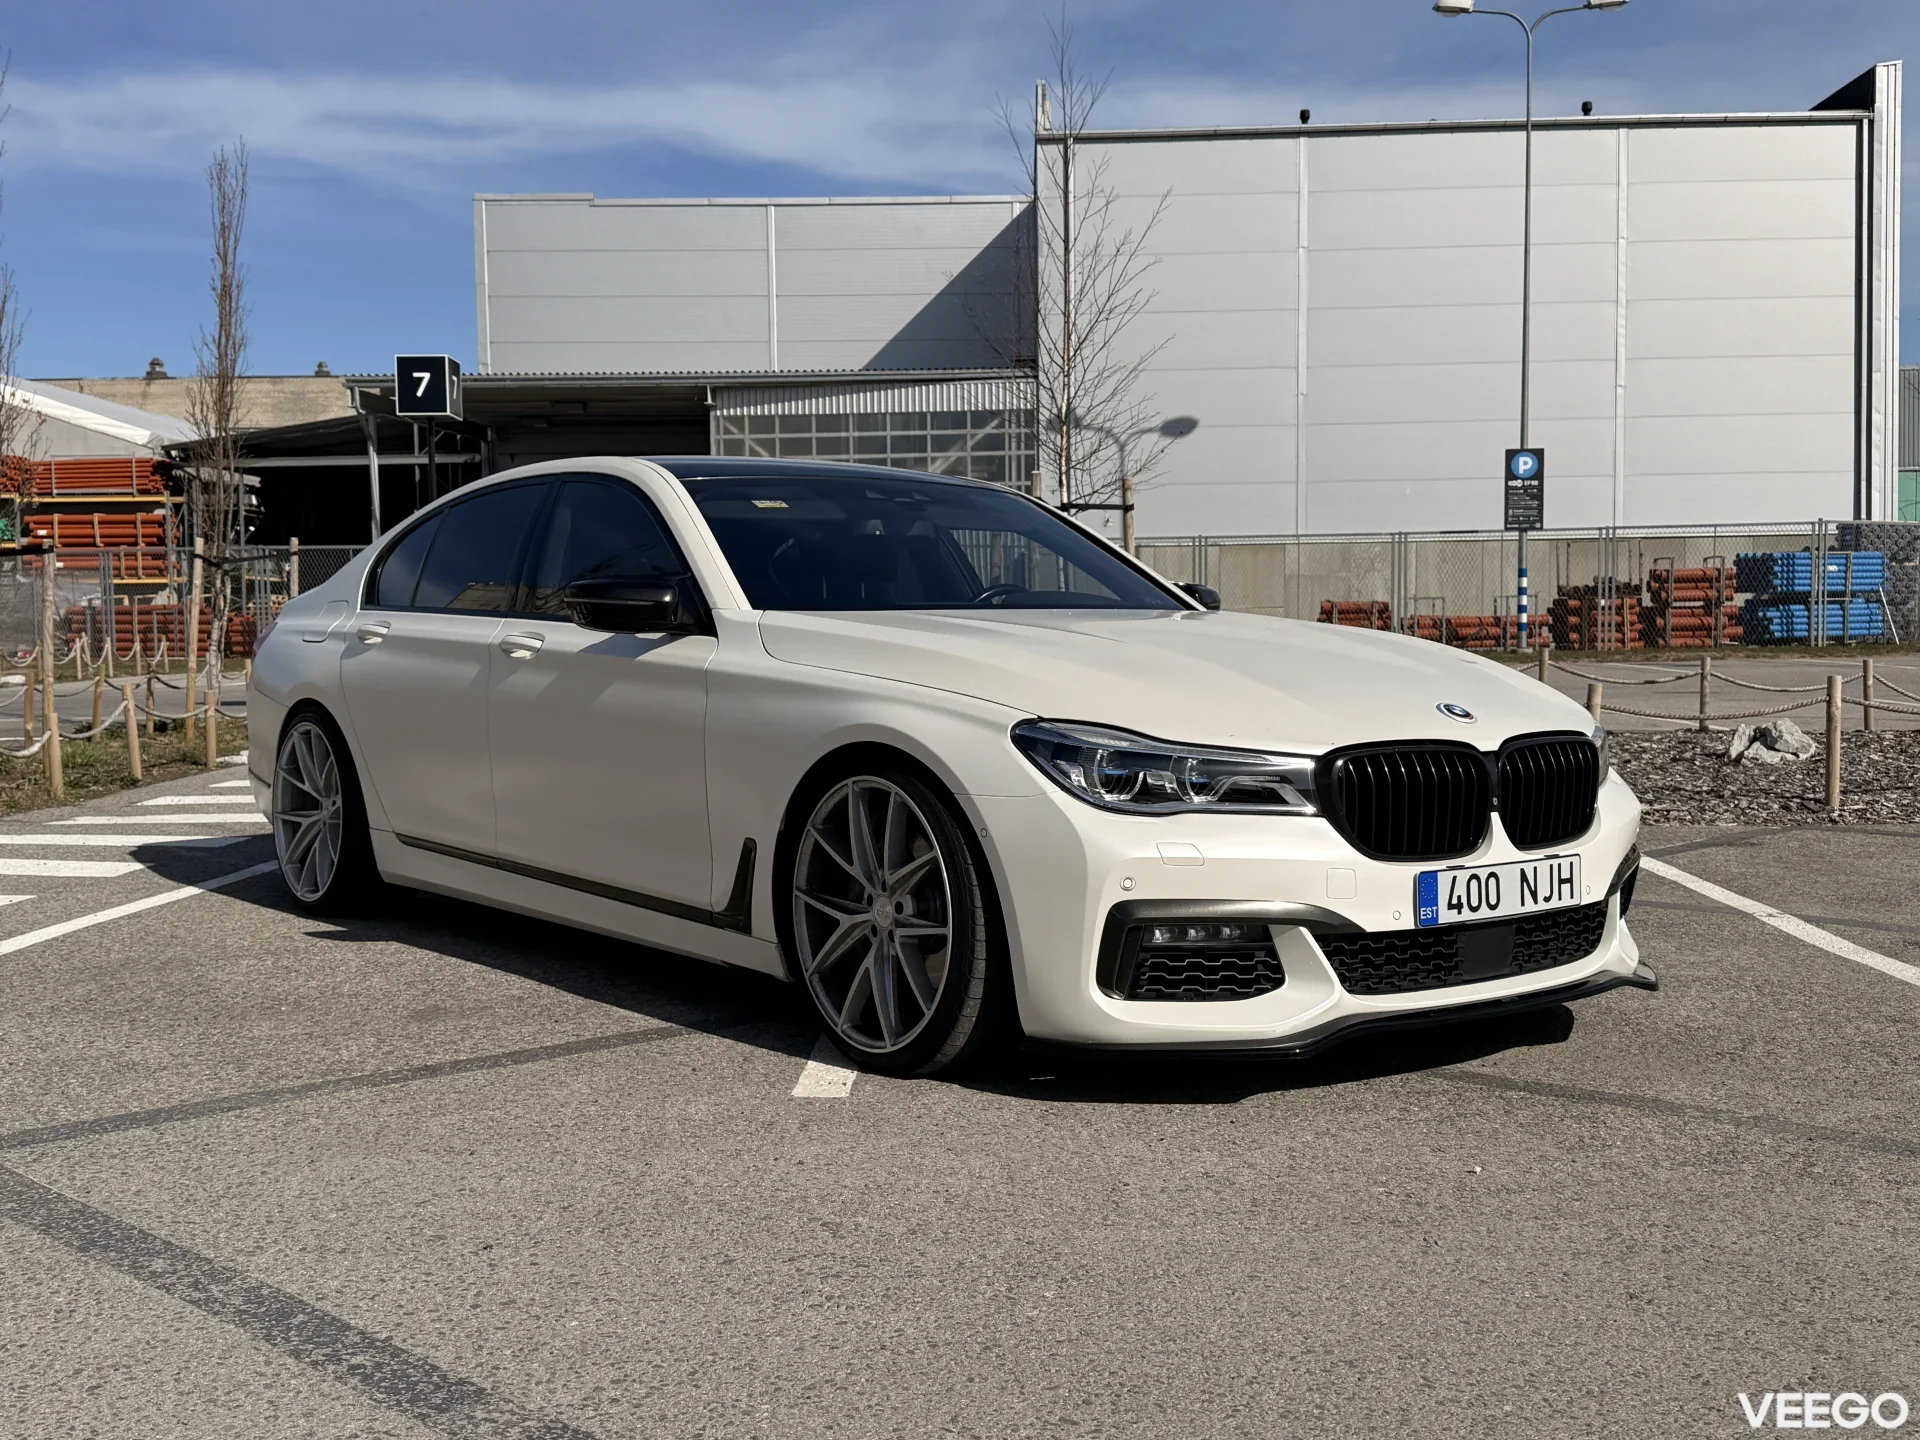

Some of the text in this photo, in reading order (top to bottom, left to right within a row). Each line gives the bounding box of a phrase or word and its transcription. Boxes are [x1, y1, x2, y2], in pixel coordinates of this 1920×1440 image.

[412, 372, 431, 398] 7
[451, 375, 458, 400] 7
[1518, 456, 1533, 474] P
[1447, 861, 1574, 915] 400 NJH
[1420, 906, 1438, 920] EST
